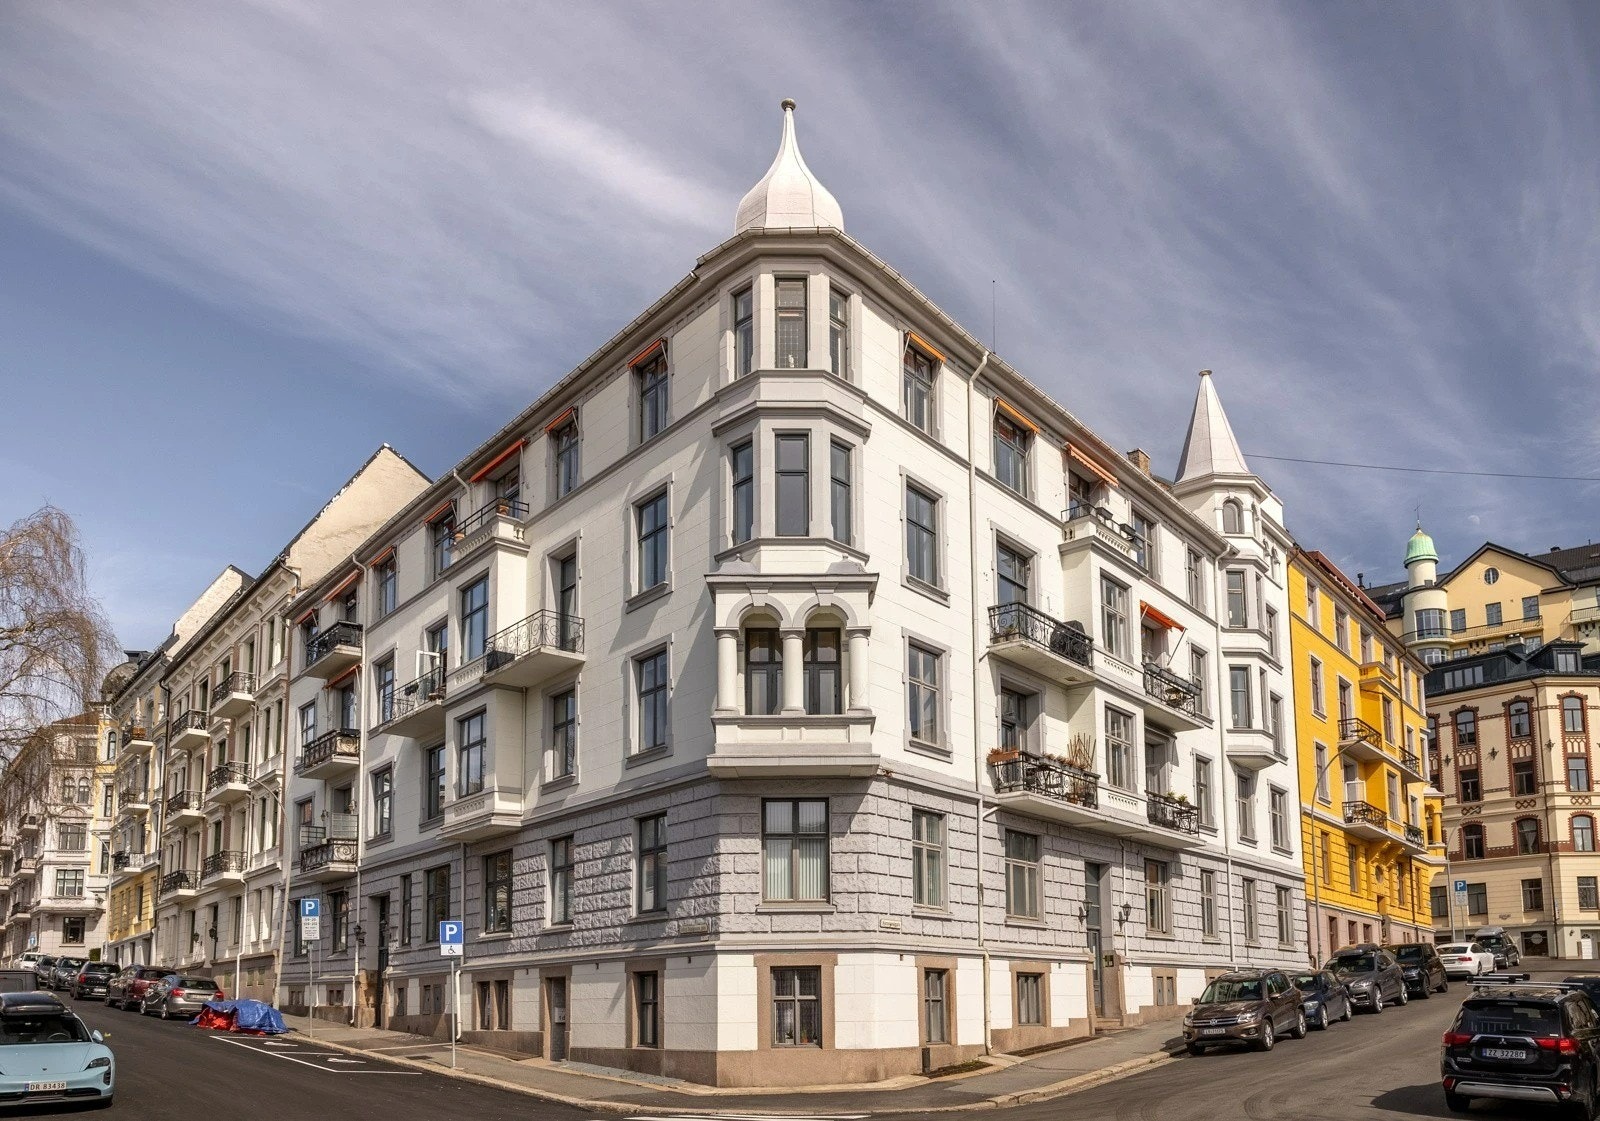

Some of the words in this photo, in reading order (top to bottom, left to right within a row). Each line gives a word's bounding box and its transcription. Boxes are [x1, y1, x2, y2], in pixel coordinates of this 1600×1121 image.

[1457, 881, 1464, 891] P
[305, 901, 315, 915] P
[445, 924, 458, 941] P
[42, 1082, 66, 1090] 83438
